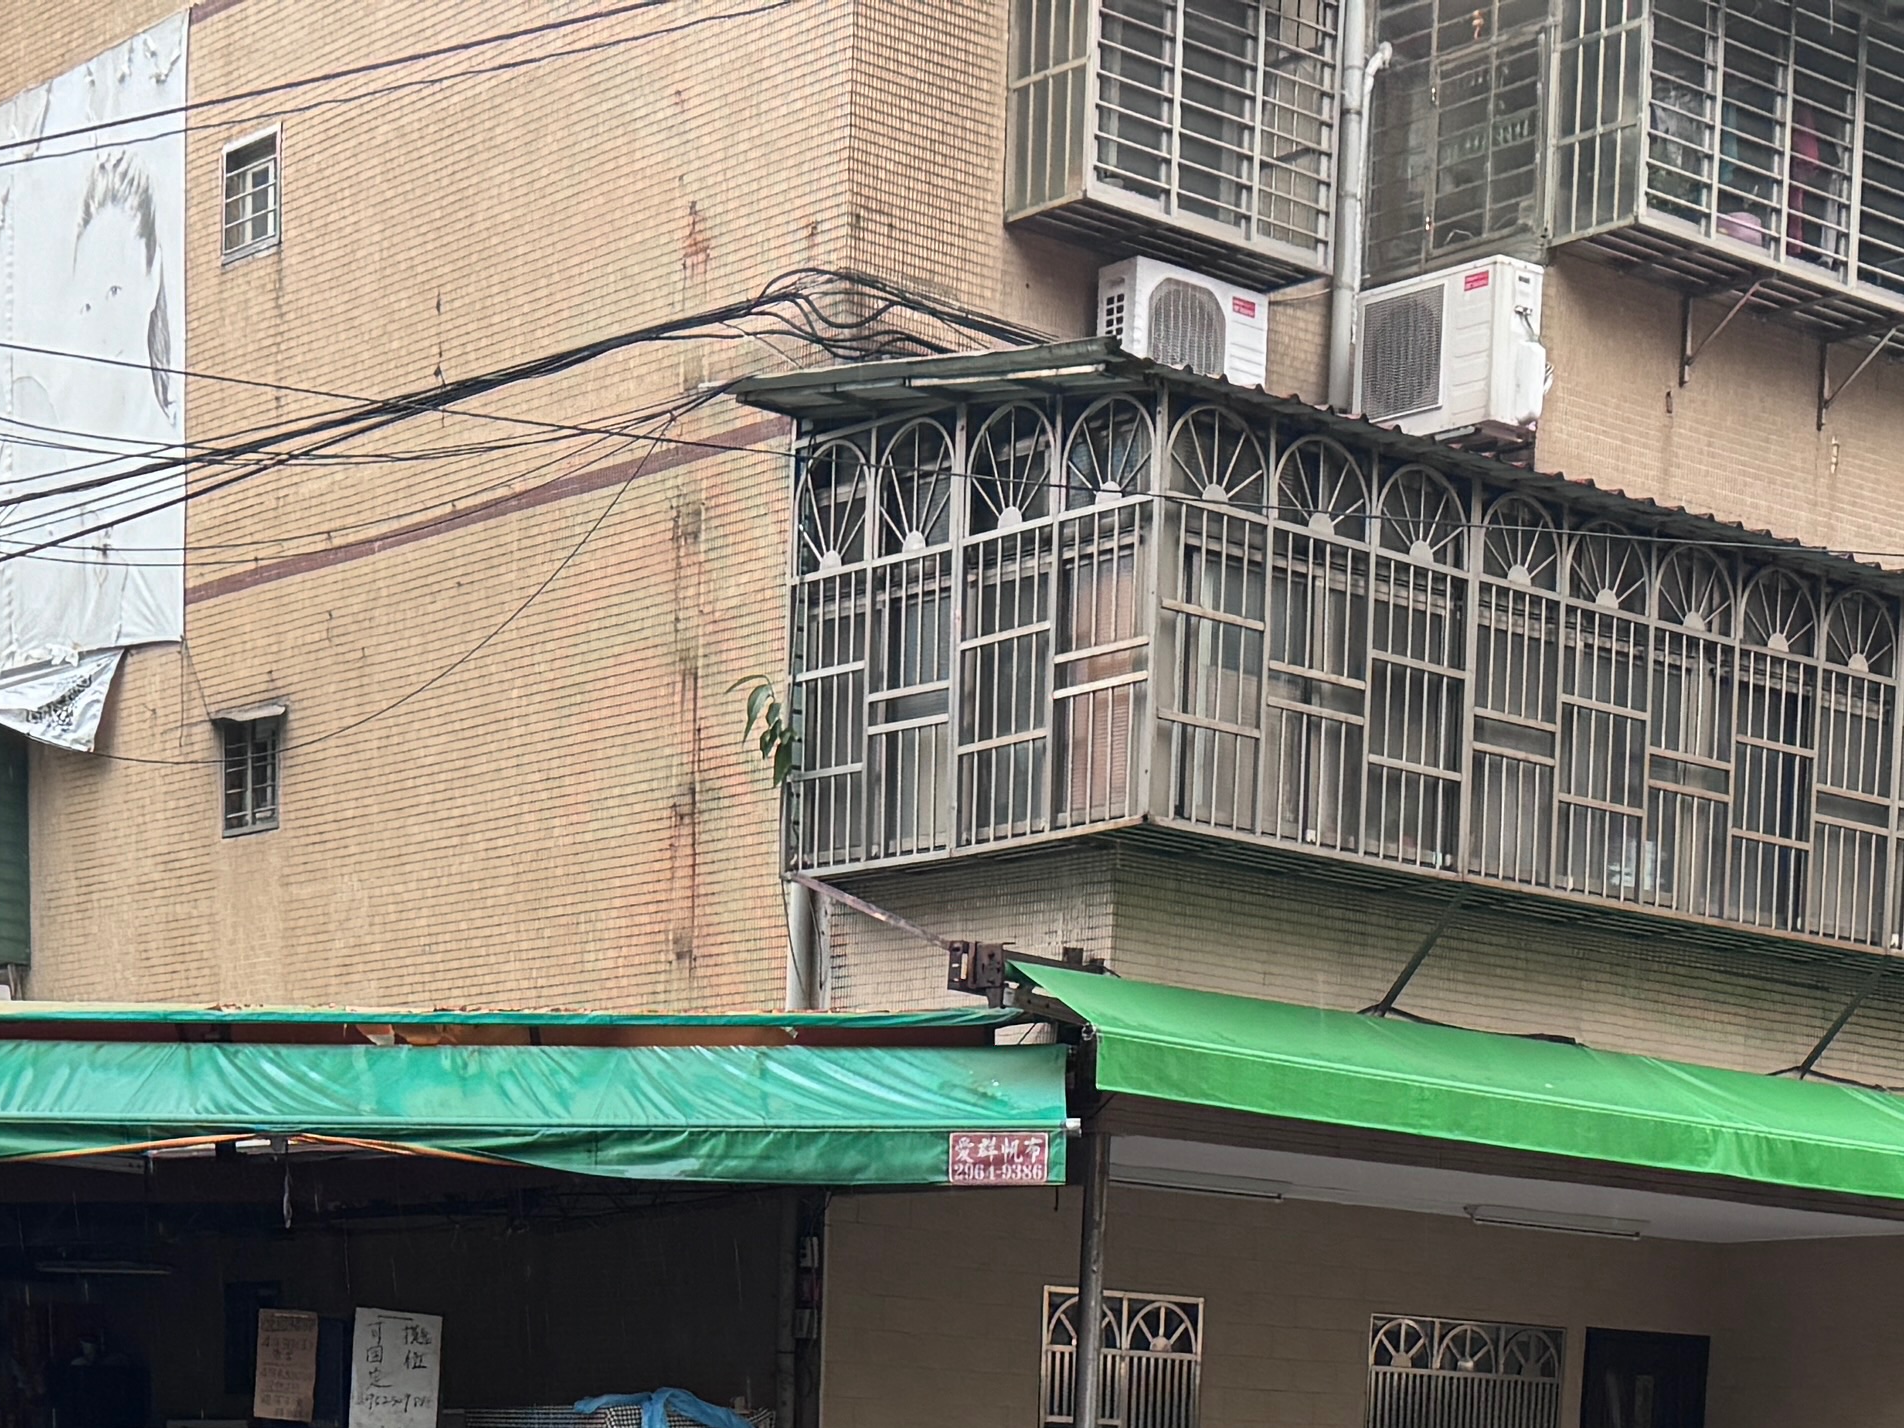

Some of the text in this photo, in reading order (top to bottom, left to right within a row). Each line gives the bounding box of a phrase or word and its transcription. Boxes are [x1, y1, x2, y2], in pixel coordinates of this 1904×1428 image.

[955, 1136, 1044, 1164] 愛群帆布
[954, 1163, 1043, 1180] 2964-9386
